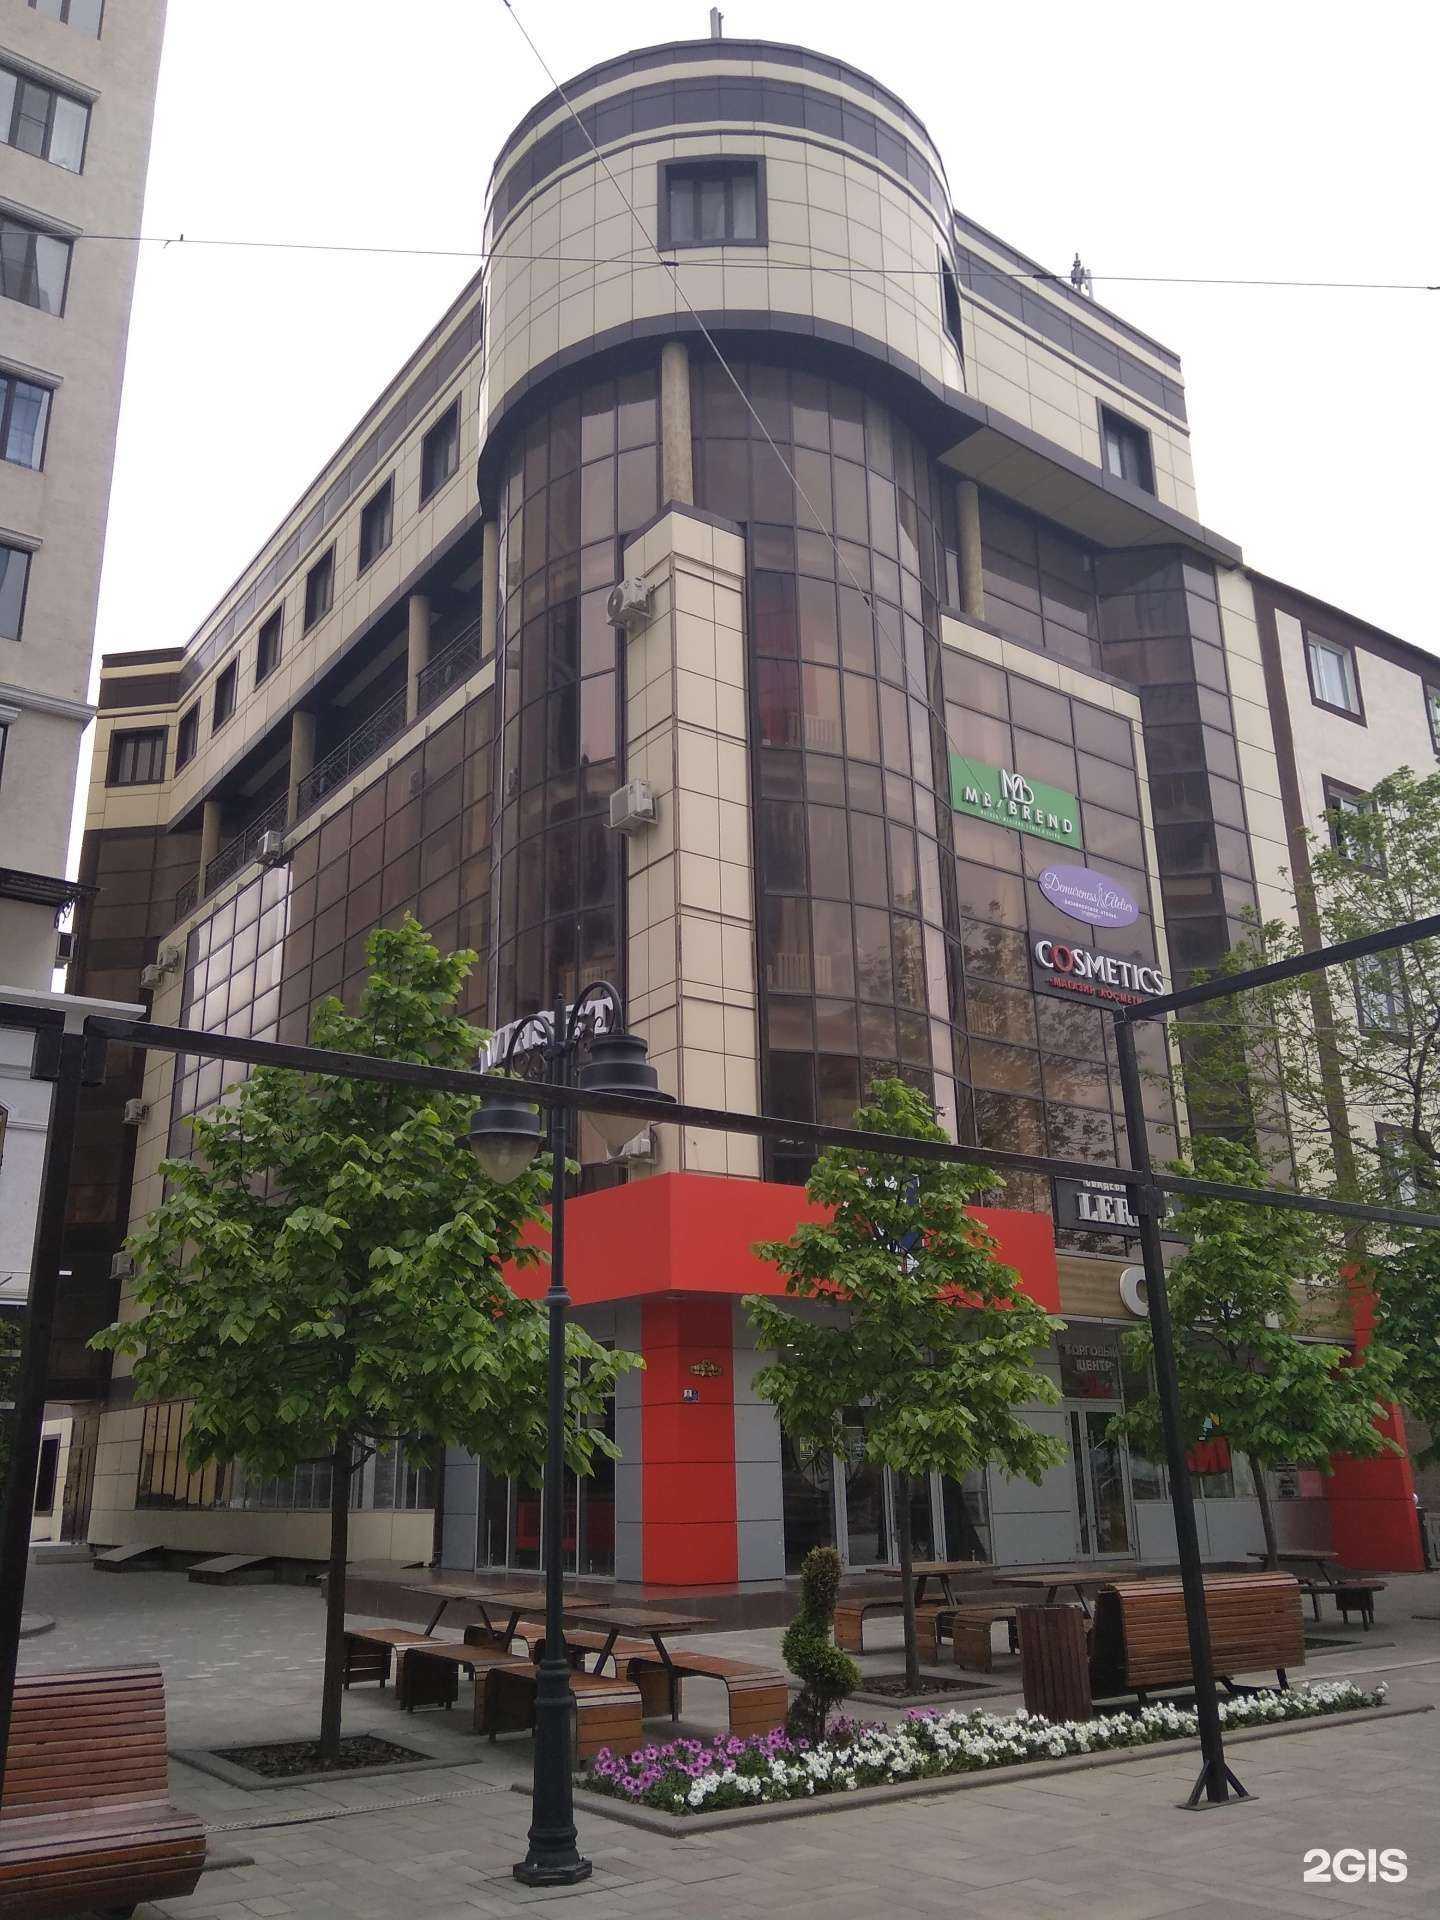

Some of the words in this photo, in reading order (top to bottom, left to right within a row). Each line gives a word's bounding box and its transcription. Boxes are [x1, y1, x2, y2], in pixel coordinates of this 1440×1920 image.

[1035, 940, 1167, 996] COSMETICS
[1049, 976, 1095, 997] МАГАЗИН
[1098, 985, 1145, 1007] КОСМЕТИ
